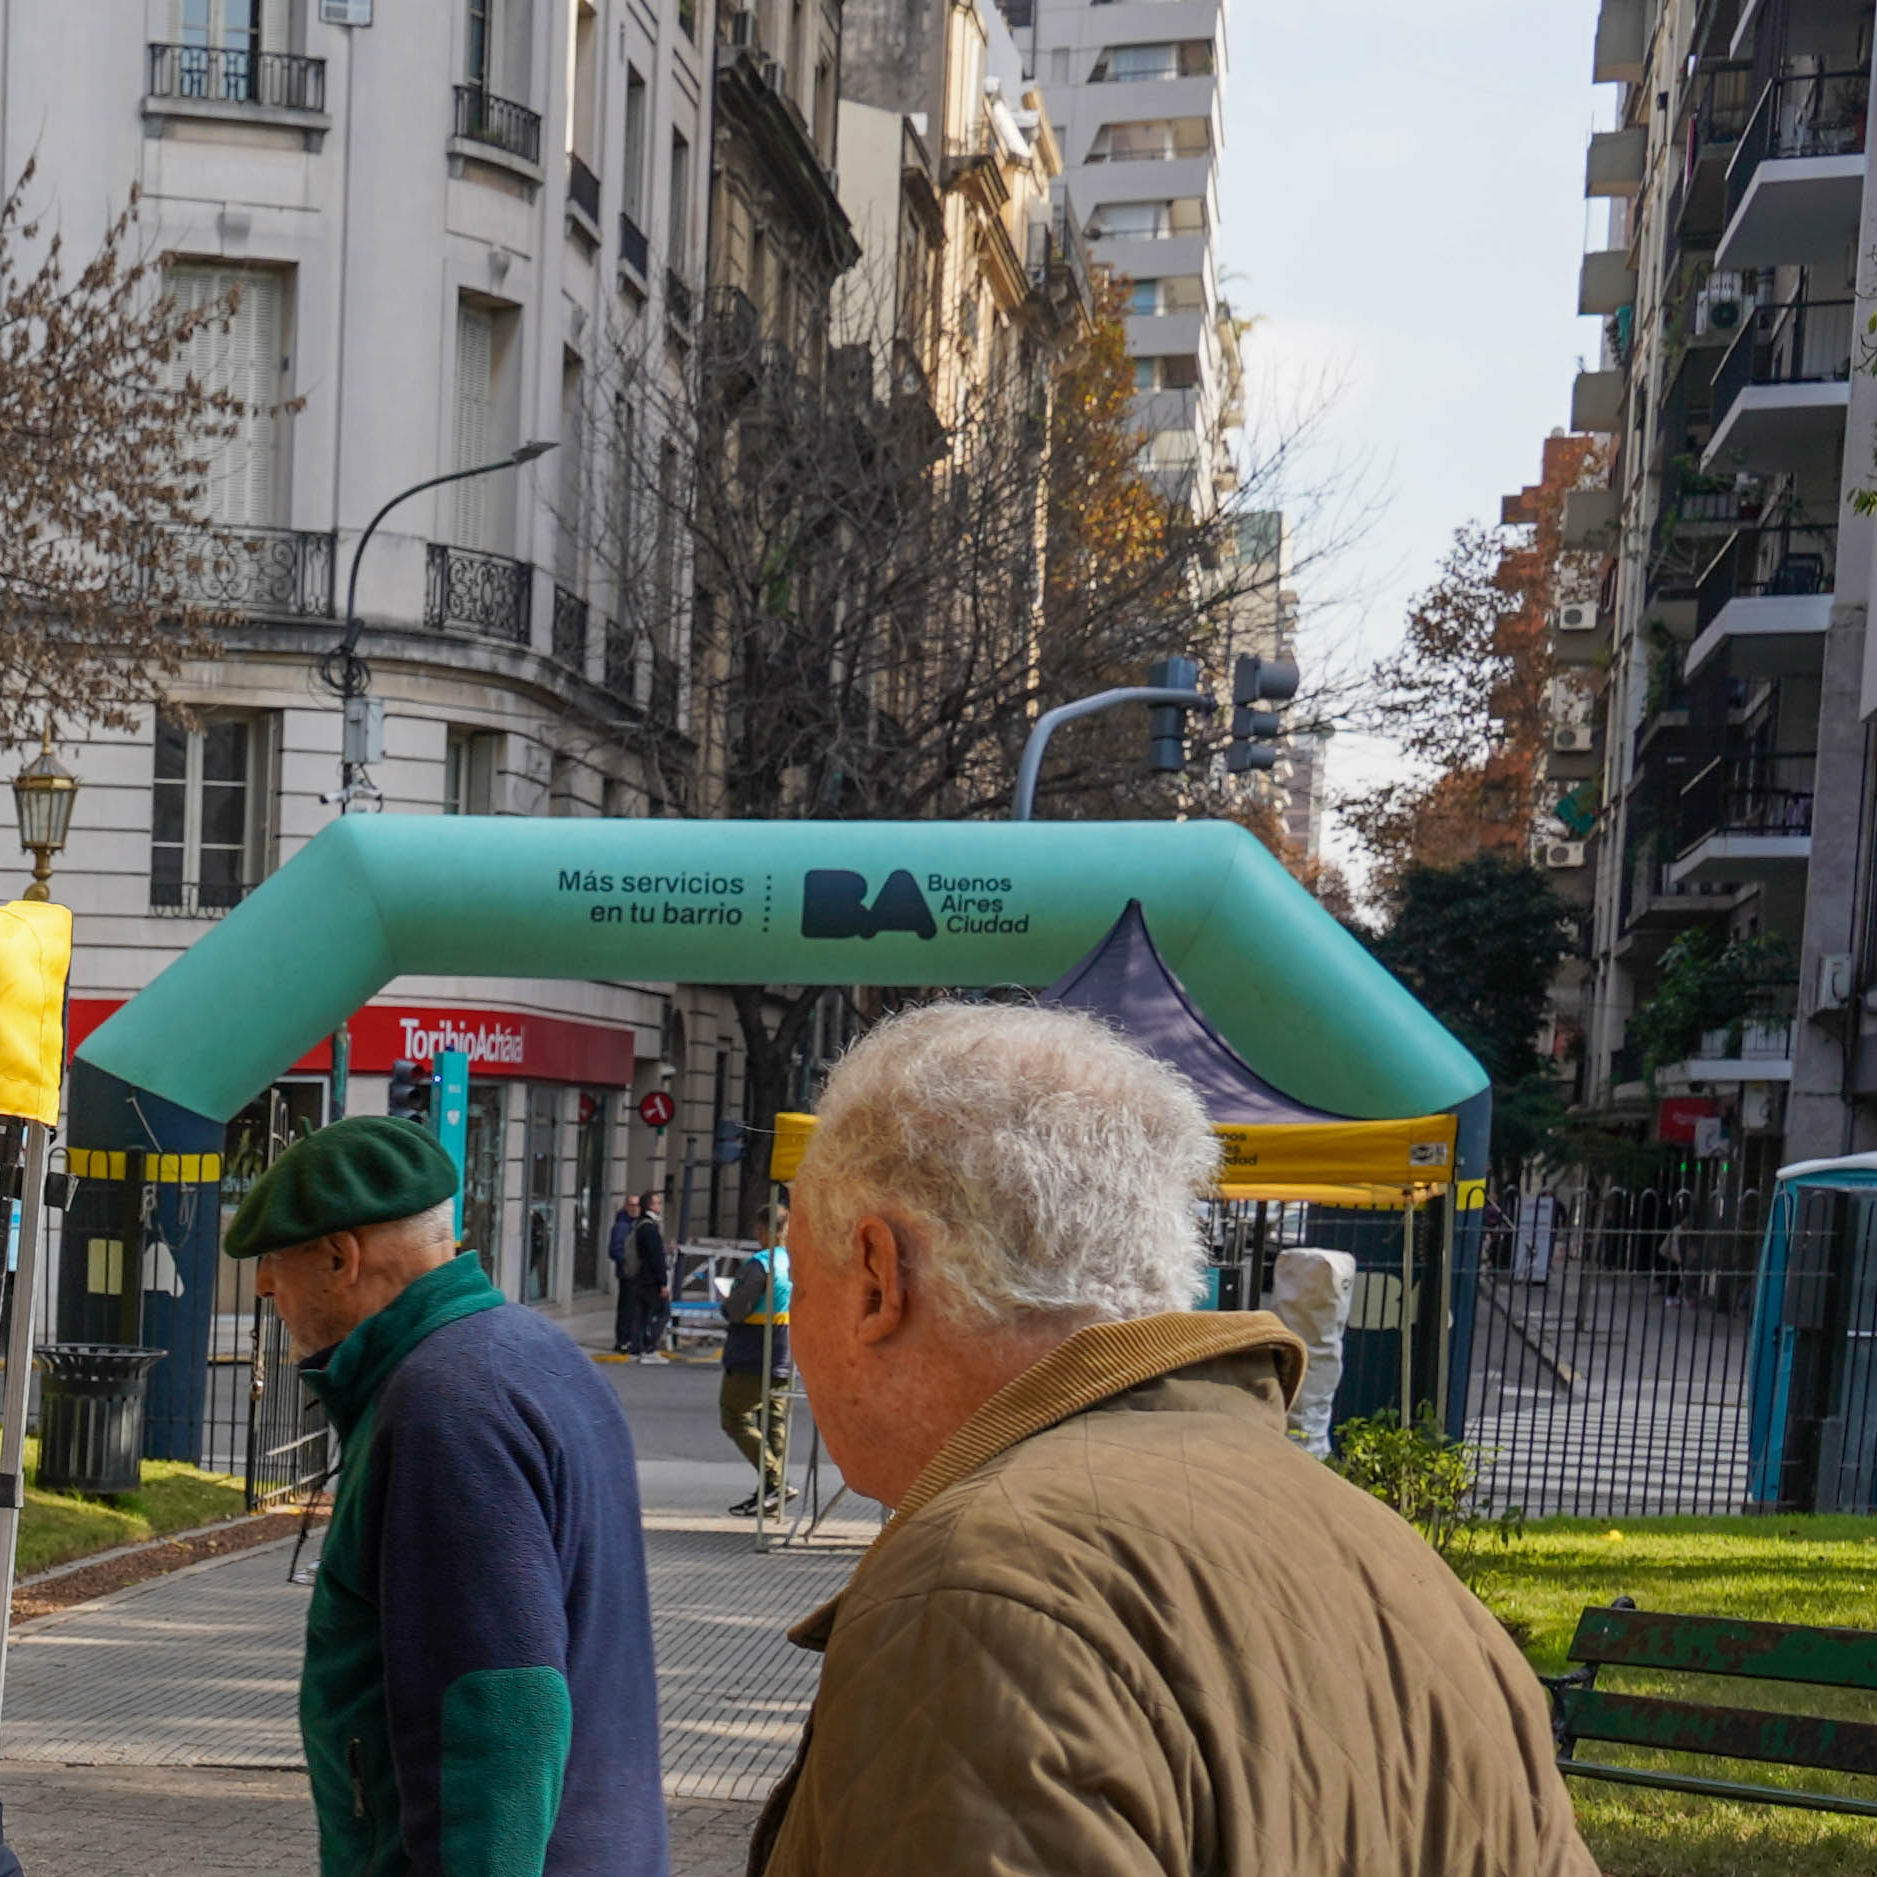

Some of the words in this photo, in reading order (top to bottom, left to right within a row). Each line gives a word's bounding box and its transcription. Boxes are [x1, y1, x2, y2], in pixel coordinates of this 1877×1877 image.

[558, 869, 617, 892] Más
[621, 873, 744, 895] servicios
[927, 874, 1012, 892] Buenos
[590, 906, 622, 923] en
[630, 905, 655, 923] tu
[663, 903, 742, 925] barrio
[801, 869, 937, 940] BA
[940, 895, 1003, 913] Aires
[946, 914, 1030, 934] Ciudad
